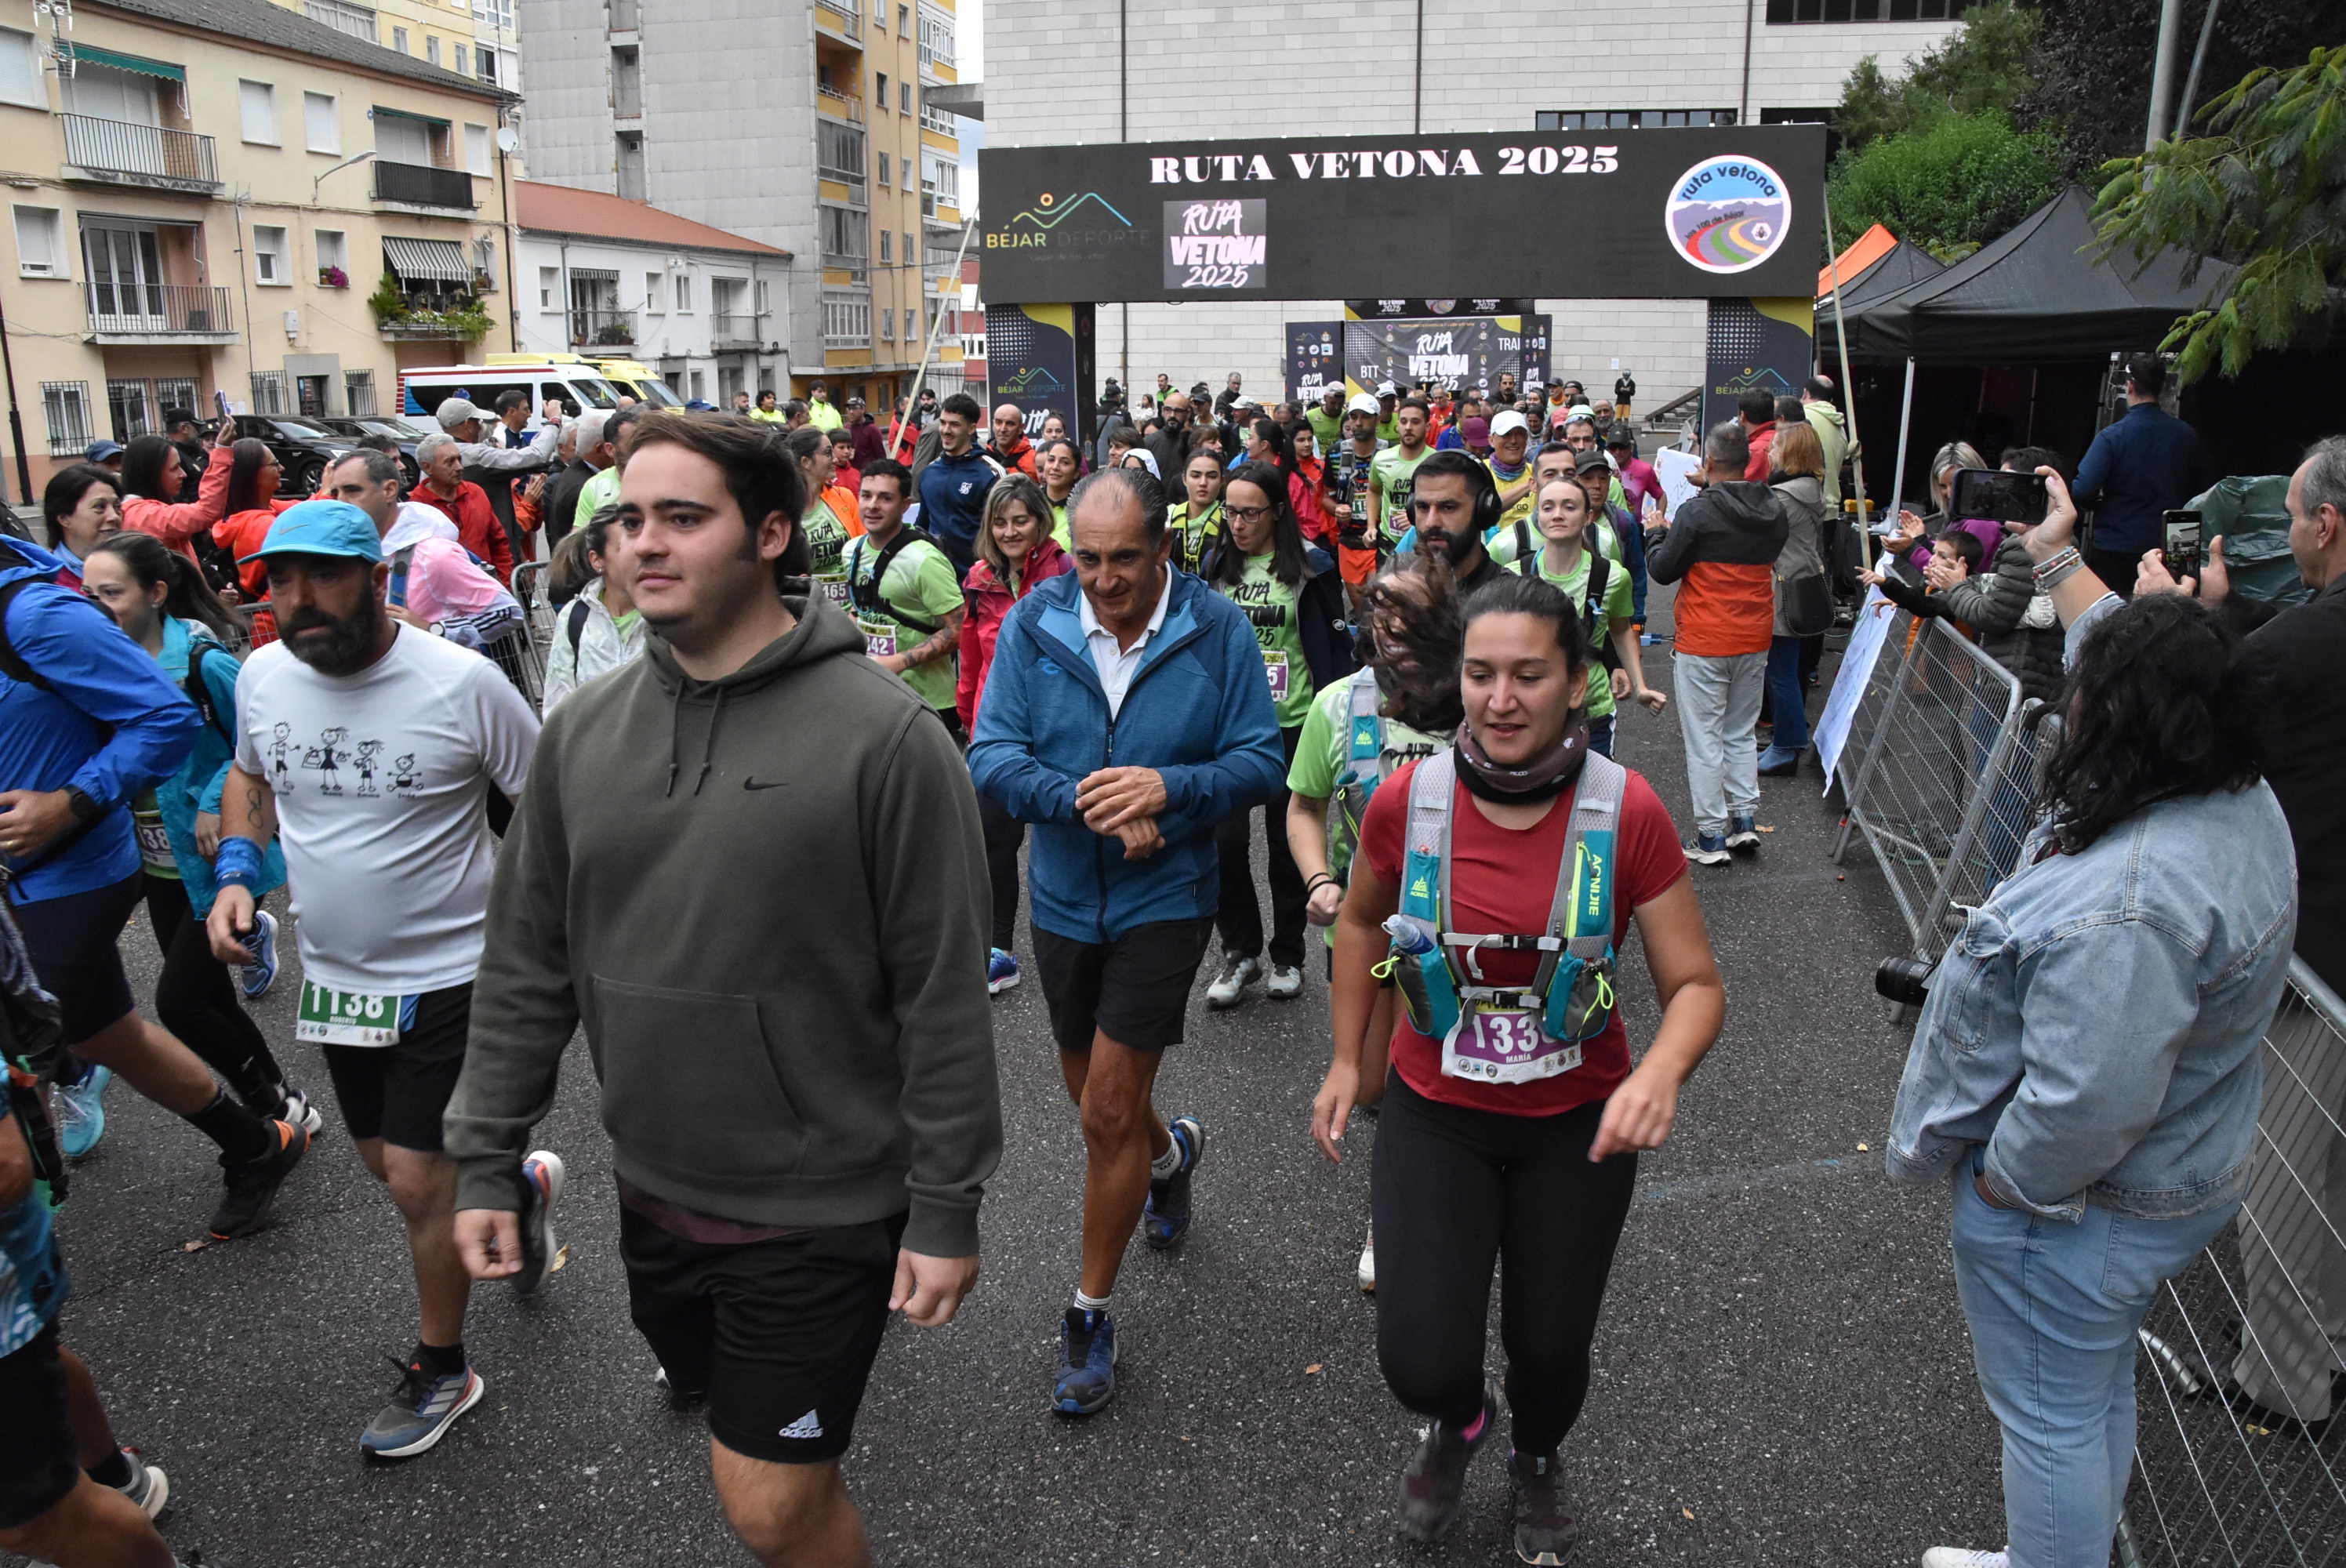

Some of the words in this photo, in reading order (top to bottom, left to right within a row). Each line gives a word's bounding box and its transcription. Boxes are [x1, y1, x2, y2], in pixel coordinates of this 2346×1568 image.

[1149, 155, 1276, 183] RUTA
[1290, 149, 1484, 180] VETONA
[1498, 145, 1618, 175] 2025
[1682, 171, 1713, 201] ruta
[1717, 165, 1777, 197] vetona
[1182, 201, 1243, 236] RUTA
[1170, 234, 1267, 266] VETONA
[1182, 264, 1249, 289] 2025
[1416, 331, 1453, 355] RUTA
[1498, 337, 1520, 351] TRAI
[1360, 365, 1379, 379] BTT
[1408, 354, 1469, 376] VETONA
[1233, 580, 1271, 606] RUTA
[1256, 628, 1275, 647] 25
[311, 985, 384, 1019] 1138
[1473, 1014, 1556, 1054] 133
[779, 1427, 823, 1439] adidas
